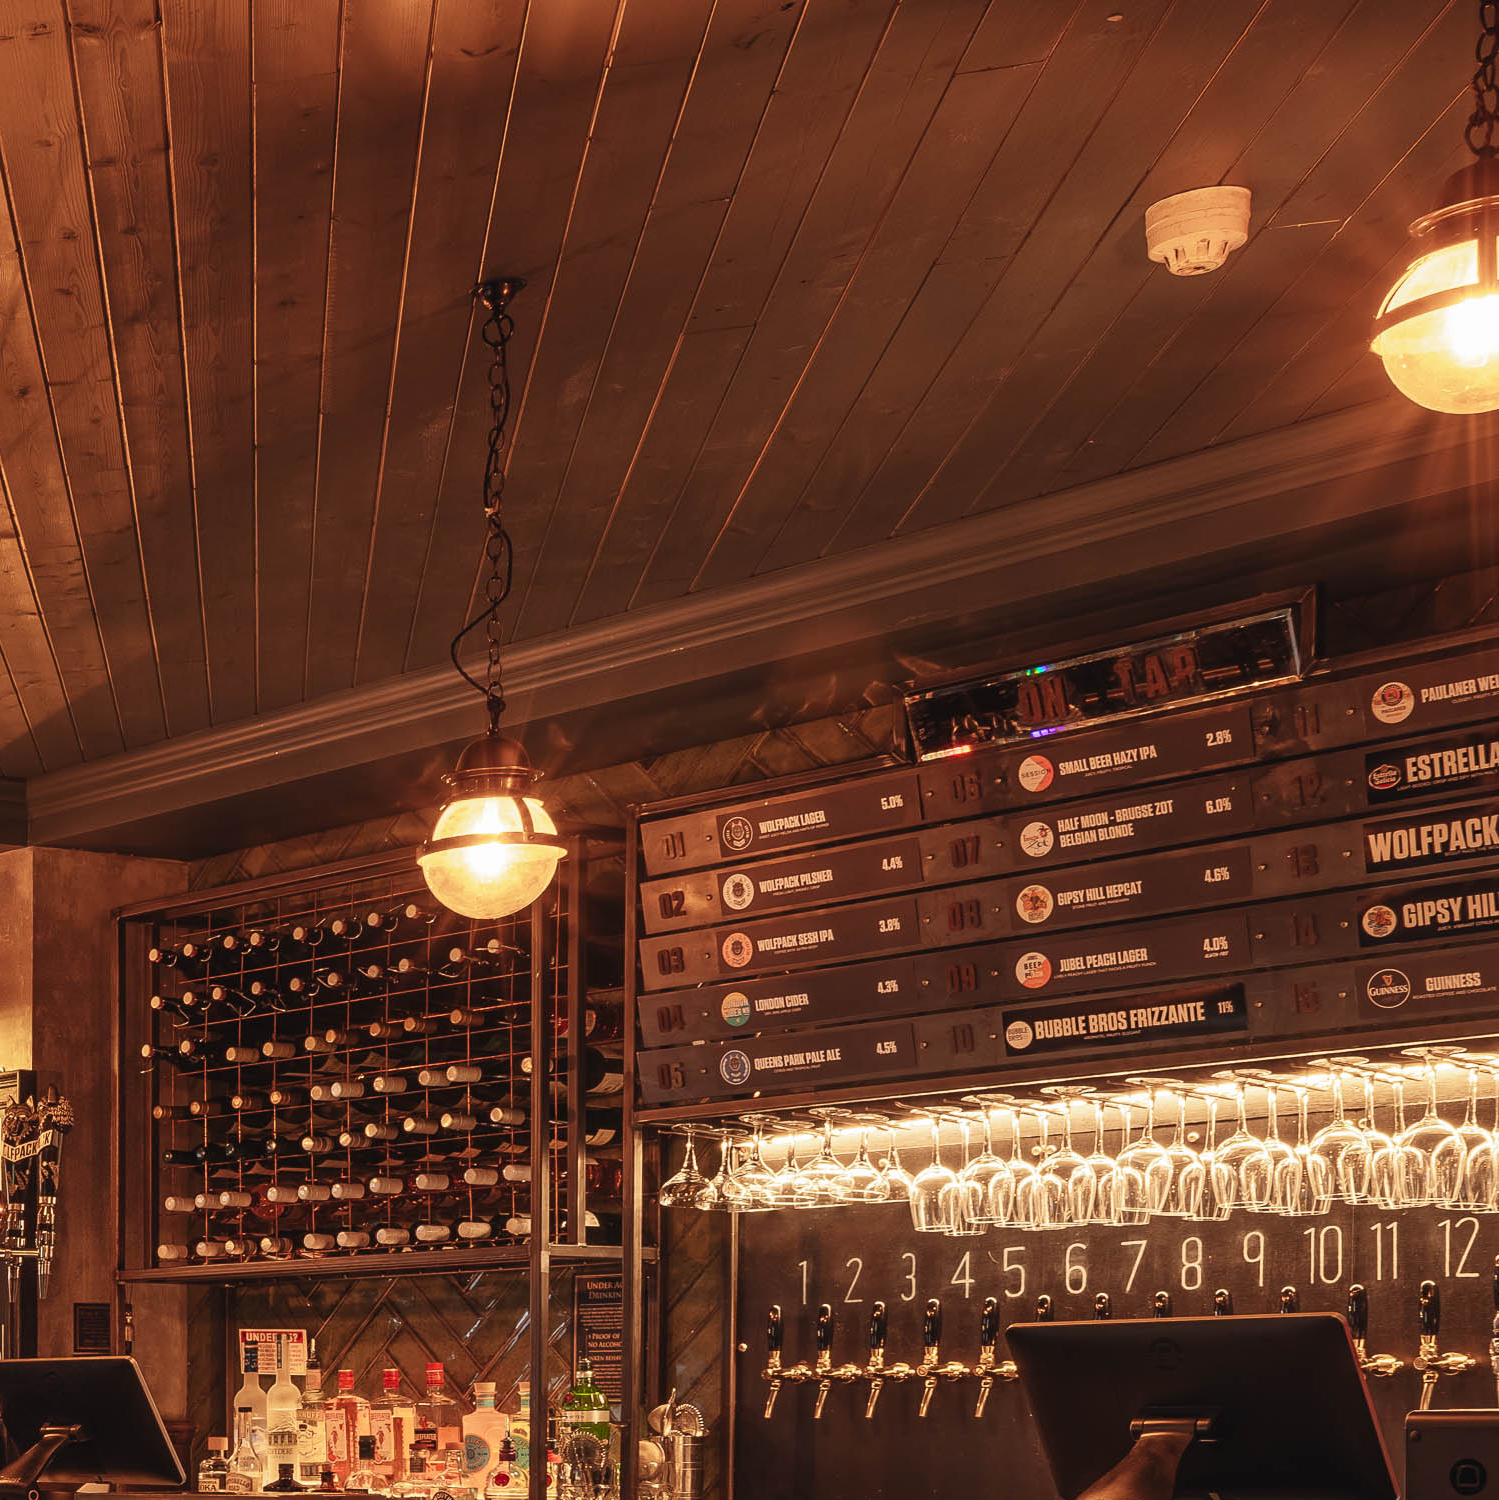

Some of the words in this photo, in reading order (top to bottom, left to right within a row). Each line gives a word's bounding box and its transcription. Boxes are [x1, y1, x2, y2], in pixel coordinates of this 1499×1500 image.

[1018, 676, 1069, 724] ON
[1115, 645, 1199, 702] TAP
[1421, 677, 1477, 703] PAULANER
[1206, 729, 1231, 746] 2.8%
[1058, 759, 1089, 777] SMALL
[1090, 754, 1112, 770] BEER
[1113, 749, 1140, 766] HAZY
[1140, 745, 1157, 761] IPA
[881, 795, 903, 810] 5.0%
[1205, 797, 1232, 814] 6.0%
[759, 815, 801, 834] WOLFPACK
[801, 810, 826, 827] LAGER
[1057, 817, 1080, 833] HALF
[1080, 812, 1108, 829] MOON
[1115, 805, 1154, 823] BRUGSE
[1154, 800, 1173, 817] ZOT
[662, 832, 686, 859] 01
[1059, 830, 1098, 848] BELGIAN
[1099, 824, 1134, 842] BLONDE
[1368, 815, 1499, 863] WOLFPACK
[882, 856, 903, 871] 4.4%
[1204, 866, 1230, 882] 4.6%
[759, 876, 800, 893] WOLFPACK
[800, 869, 833, 887] PILSNER
[658, 891, 687, 919] 02
[1057, 888, 1086, 906] GIPSY
[1086, 885, 1105, 902] HILL
[1106, 881, 1142, 899] HEPCAT
[1402, 896, 1462, 928] GIPSY
[879, 918, 901, 932] 3.8%
[757, 934, 798, 952] WOLFPACK
[798, 931, 819, 947] SESH
[819, 929, 833, 943] IPA
[1203, 937, 1228, 952] 4.0%
[657, 947, 685, 975] 03
[1059, 956, 1085, 972] JUBEL
[1086, 953, 1116, 969] PEACH
[1117, 948, 1148, 965] LAGER
[877, 980, 899, 994] 4.3%
[1369, 984, 1408, 997] GUINNESS
[1425, 972, 1482, 992] GUINNESS
[755, 996, 786, 1012] LONDON
[786, 994, 809, 1009] CIDER
[1217, 1001, 1233, 1015] 11%
[657, 1004, 686, 1033] 04
[1034, 1016, 1087, 1040] BUBBLE
[1089, 1010, 1127, 1034] BROS
[1129, 1001, 1206, 1029] FRIZZANTE
[754, 1055, 783, 1071] QUEENS
[784, 1053, 806, 1067] PARK
[806, 1051, 826, 1065] PALE
[826, 1049, 841, 1062] ALE
[876, 1041, 897, 1055] 4.5%
[657, 1061, 685, 1090] 05
[798, 1261, 807, 1305] 1
[844, 1257, 863, 1303] 2
[901, 1252, 916, 1301] 3
[951, 1251, 975, 1298] 4
[1003, 1246, 1026, 1298] 5
[1065, 1243, 1088, 1294] 6
[1120, 1240, 1148, 1294] 7
[1181, 1237, 1202, 1290] 8
[1243, 1231, 1265, 1287] 9
[1303, 1225, 1343, 1285] 10
[1370, 1221, 1398, 1281] 11
[1437, 1217, 1480, 1278] 12
[587, 1281, 612, 1290] UNDER
